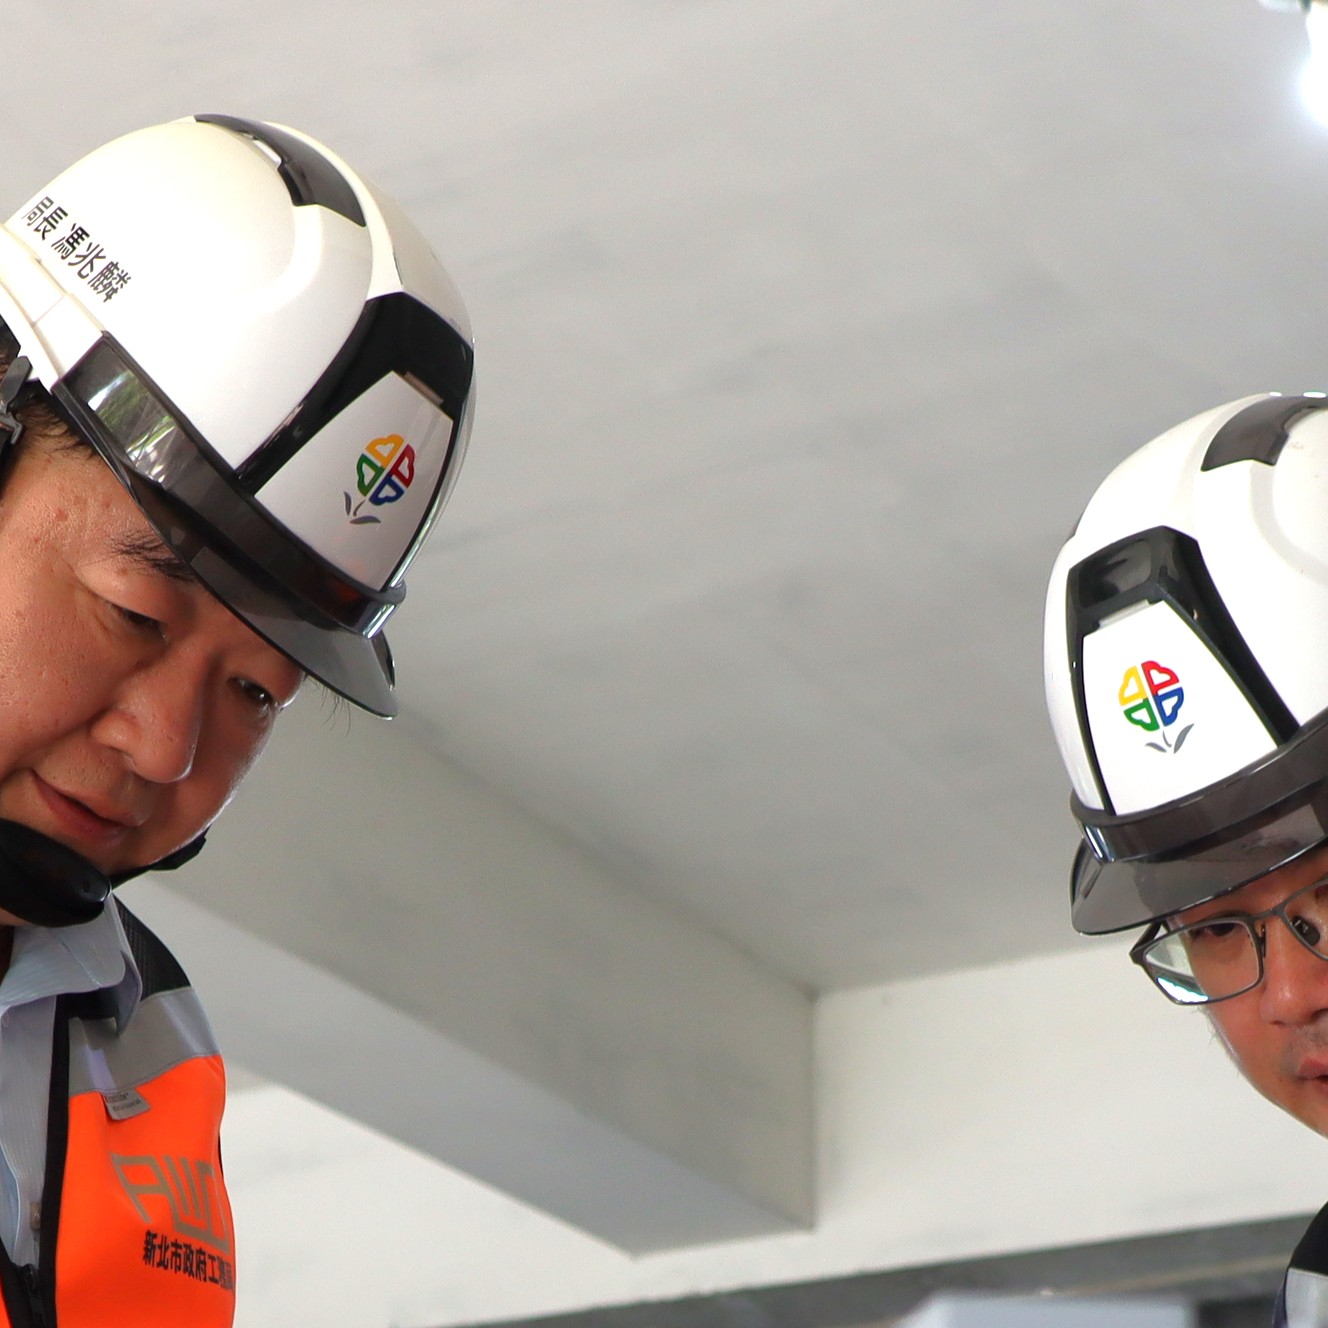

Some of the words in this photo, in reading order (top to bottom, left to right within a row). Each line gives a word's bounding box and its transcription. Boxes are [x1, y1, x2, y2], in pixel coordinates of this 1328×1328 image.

[21, 196, 69, 241] 局長
[51, 222, 132, 304] 馮兆麟
